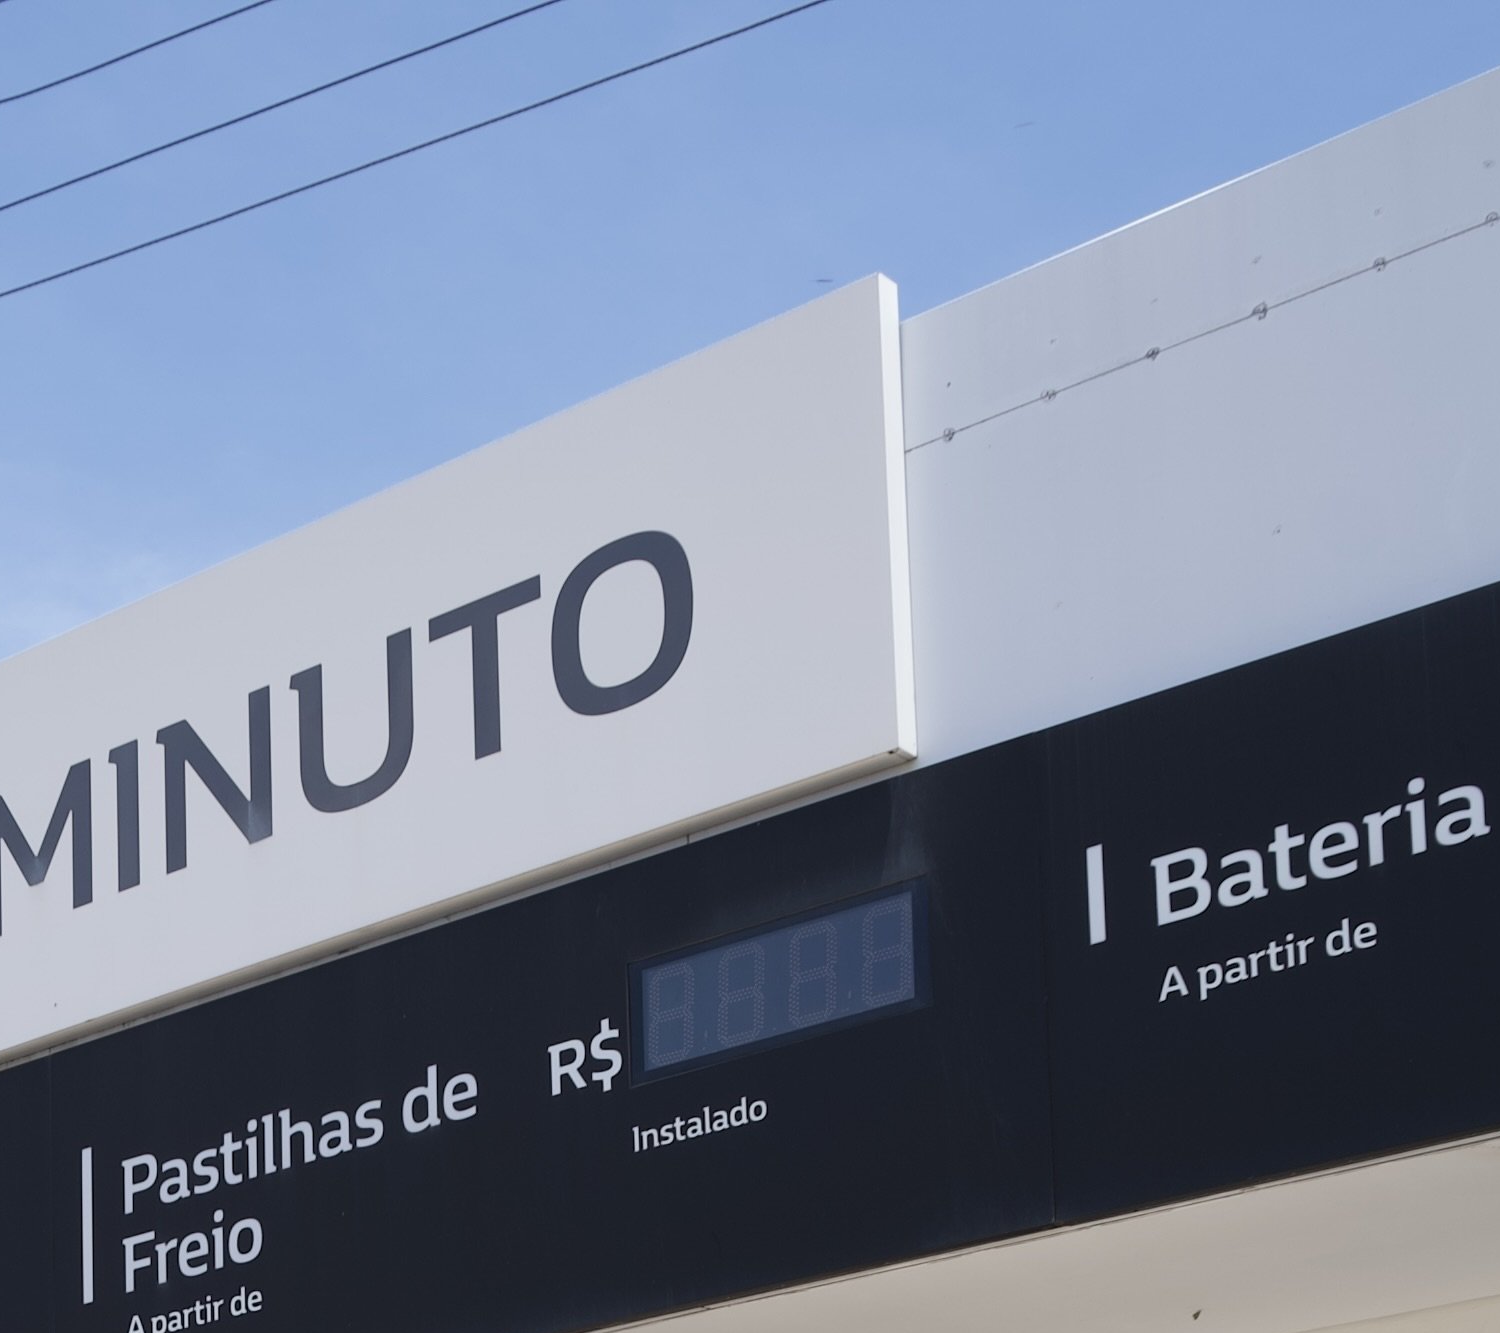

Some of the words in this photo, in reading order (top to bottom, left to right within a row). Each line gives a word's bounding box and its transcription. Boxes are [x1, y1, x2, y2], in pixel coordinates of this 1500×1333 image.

[1149, 777, 1491, 927] Bateria
[1159, 966, 1190, 1003] A
[1197, 931, 1315, 1002] partir
[1325, 914, 1379, 955] de
[547, 1018, 624, 1097] R$
[121, 1099, 384, 1215] Pastilhas
[402, 1064, 478, 1135] de
[631, 1096, 768, 1153] Instalado
[122, 1209, 264, 1294] Freio
[228, 1285, 263, 1319] de
